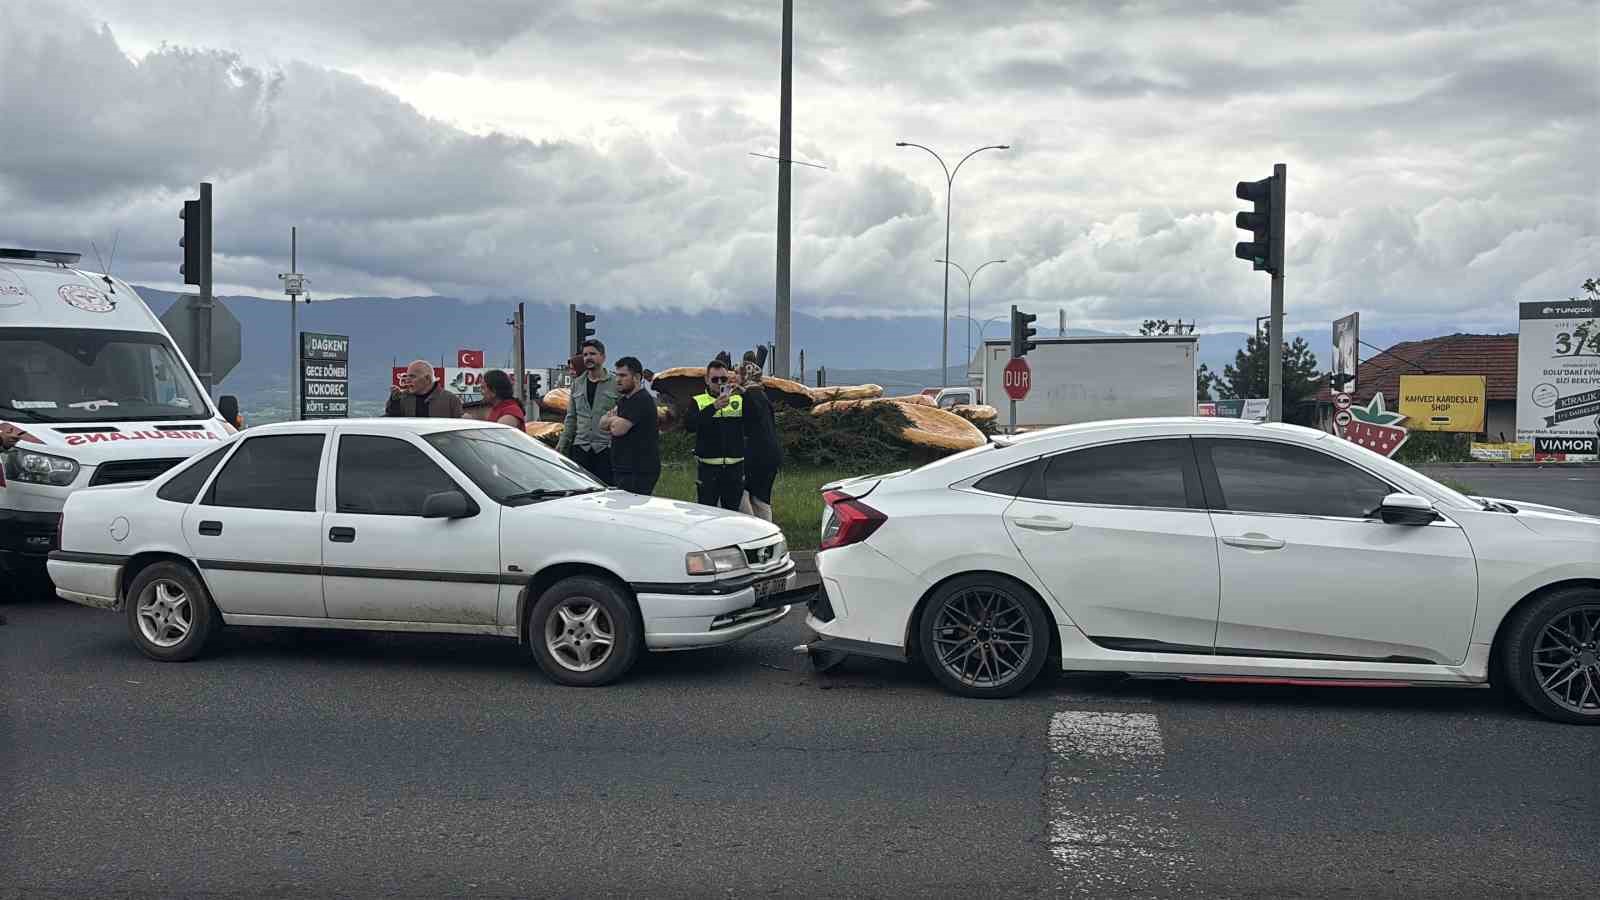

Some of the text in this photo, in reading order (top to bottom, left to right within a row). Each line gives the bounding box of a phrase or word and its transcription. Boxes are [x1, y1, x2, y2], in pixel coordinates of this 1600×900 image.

[306, 365, 323, 377] GECE
[1006, 370, 1028, 388] DUR
[1431, 403, 1451, 412] SHOP
[1540, 439, 1593, 450] VIAMOR
